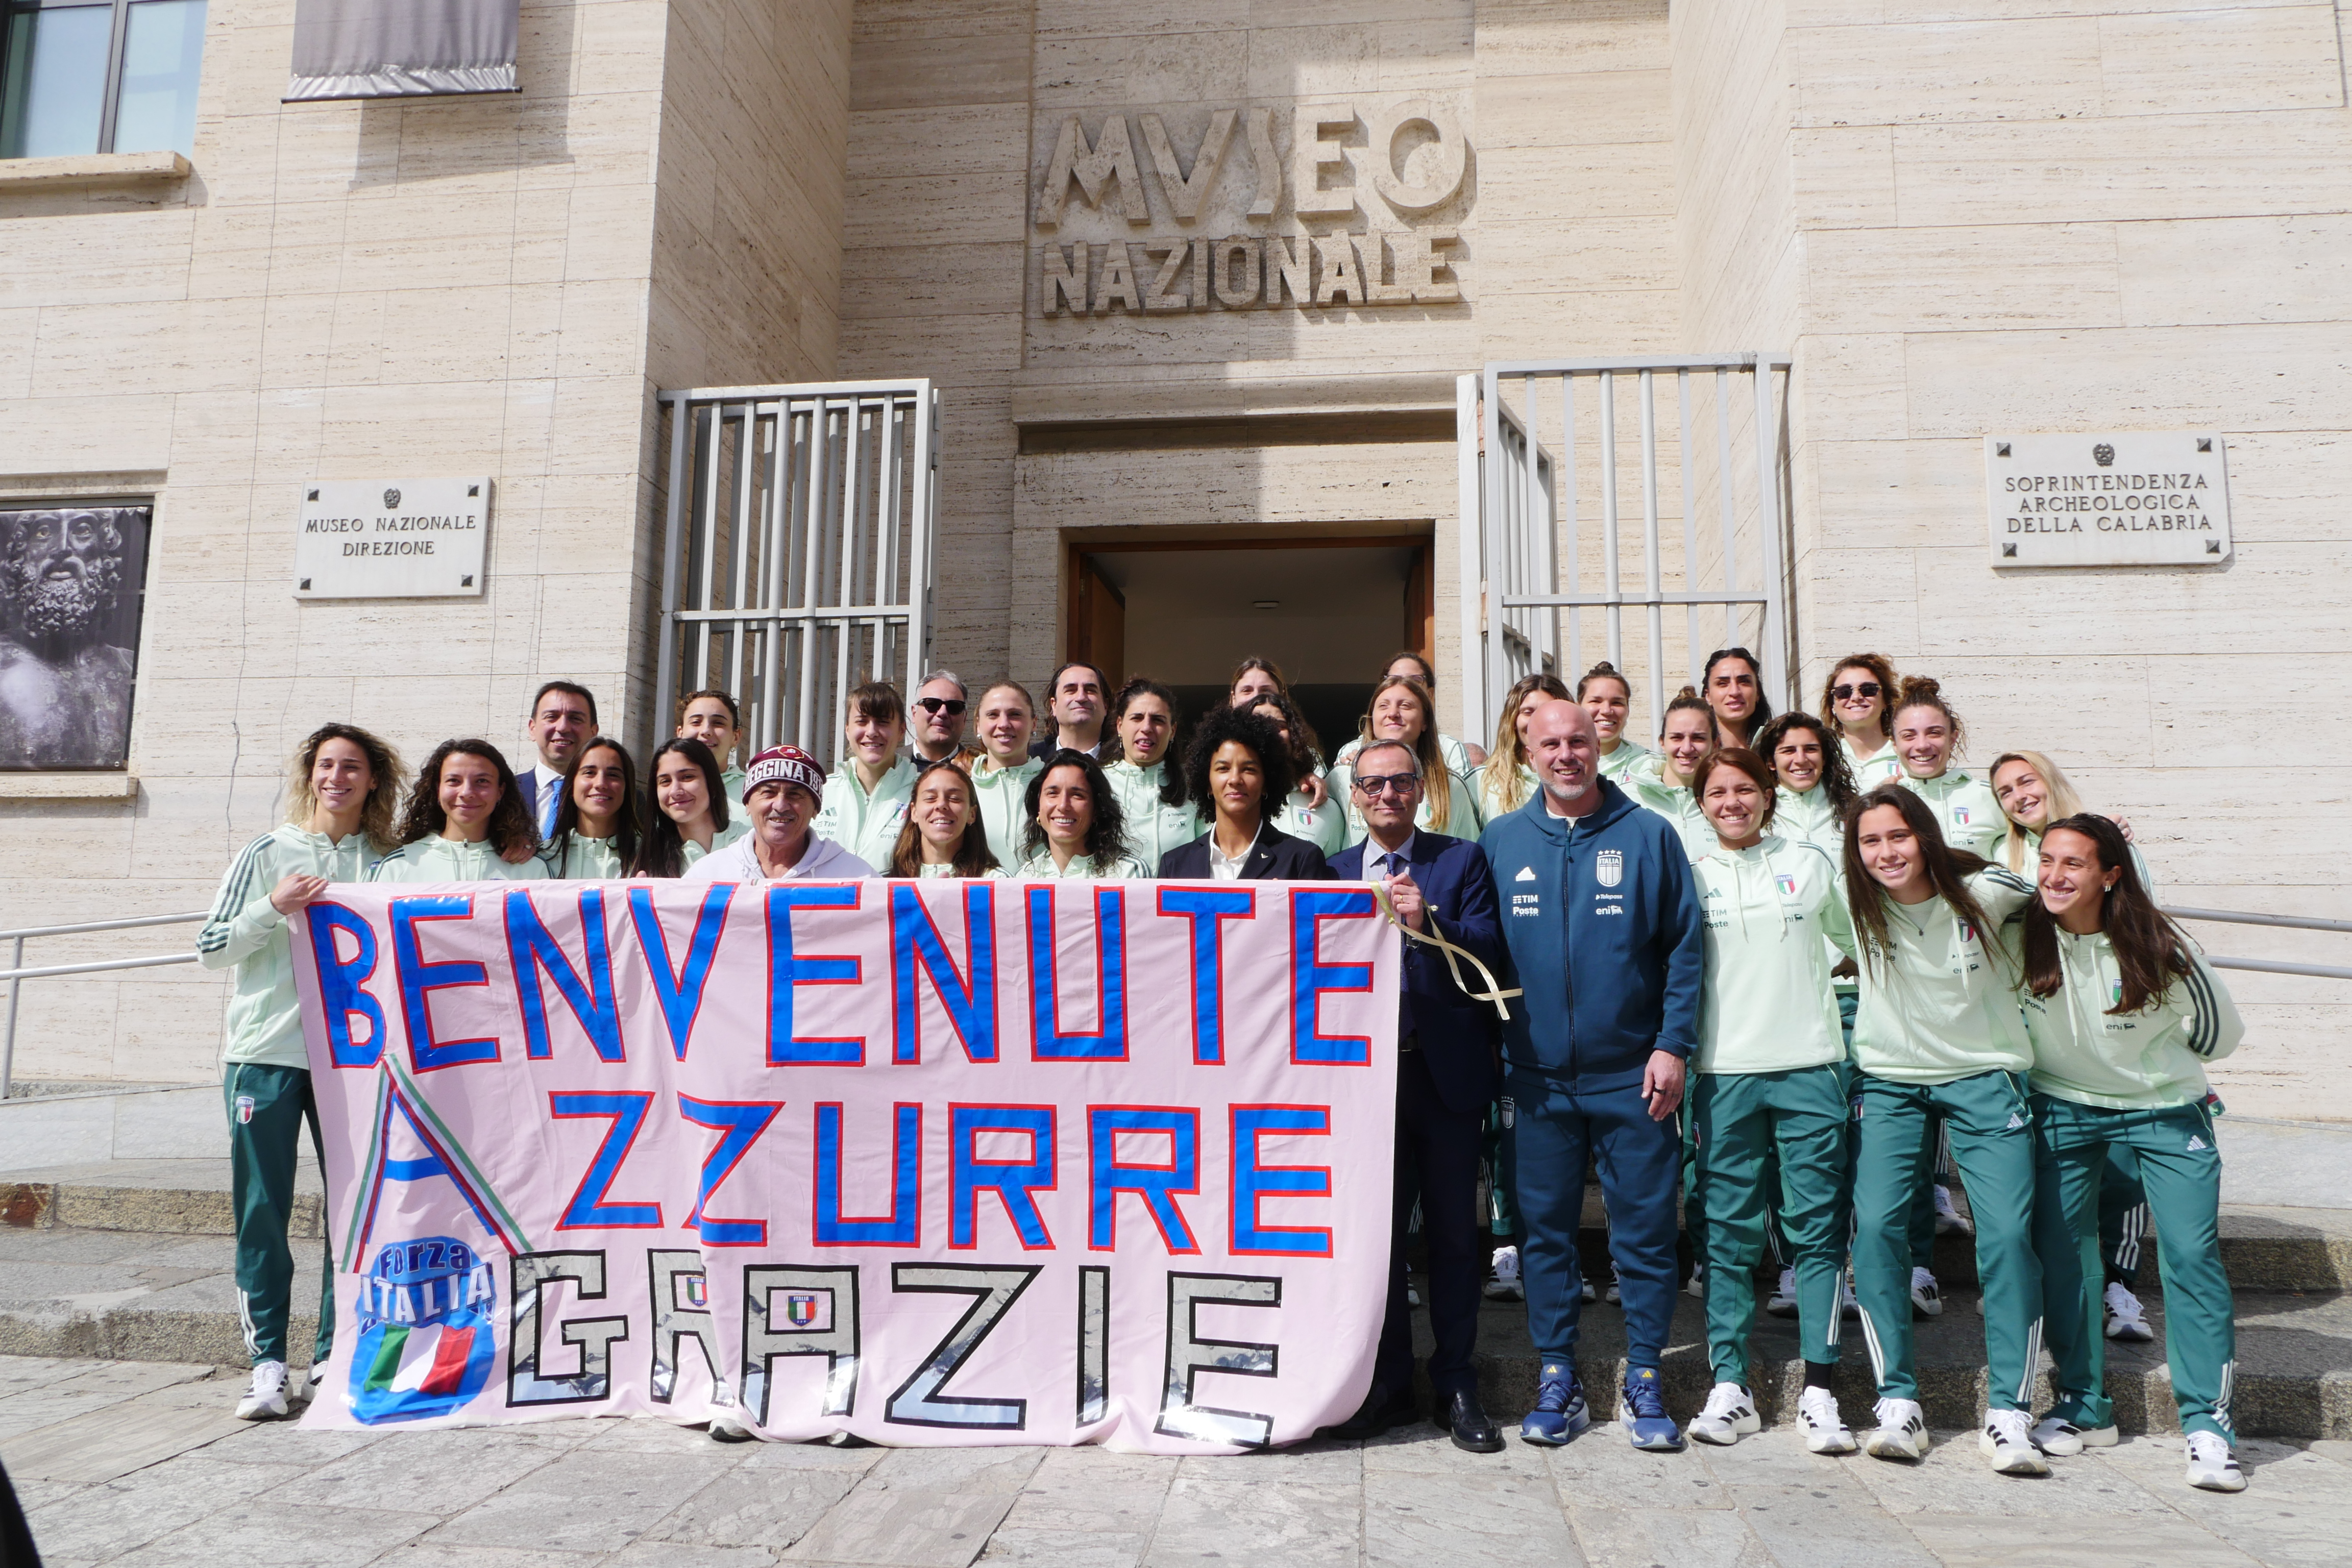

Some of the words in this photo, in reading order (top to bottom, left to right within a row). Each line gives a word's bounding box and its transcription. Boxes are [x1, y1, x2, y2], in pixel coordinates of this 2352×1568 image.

[1043, 227, 1459, 317] NAZIONALE
[2005, 473, 2208, 492] SOPRINTENDENZA
[2019, 494, 2200, 512] ARCHEOLOGICA
[306, 519, 364, 533] MUSEO
[376, 515, 476, 531] NAZIONALE
[2007, 517, 2083, 533] DELLA
[2097, 514, 2212, 531] CALABRIA
[342, 541, 435, 556] DIREZIONE
[745, 761, 804, 789] REGGINA
[1522, 894, 1538, 903] TIM
[1596, 905, 1610, 915] eni
[1710, 909, 1727, 917] TIM
[1704, 921, 1728, 929] Poste
[305, 881, 1377, 1074] BENVENUTE
[340, 1053, 1334, 1273] AZZURRE
[360, 1263, 493, 1324] ITALIA
[505, 1248, 1283, 1449] GRAZIE
